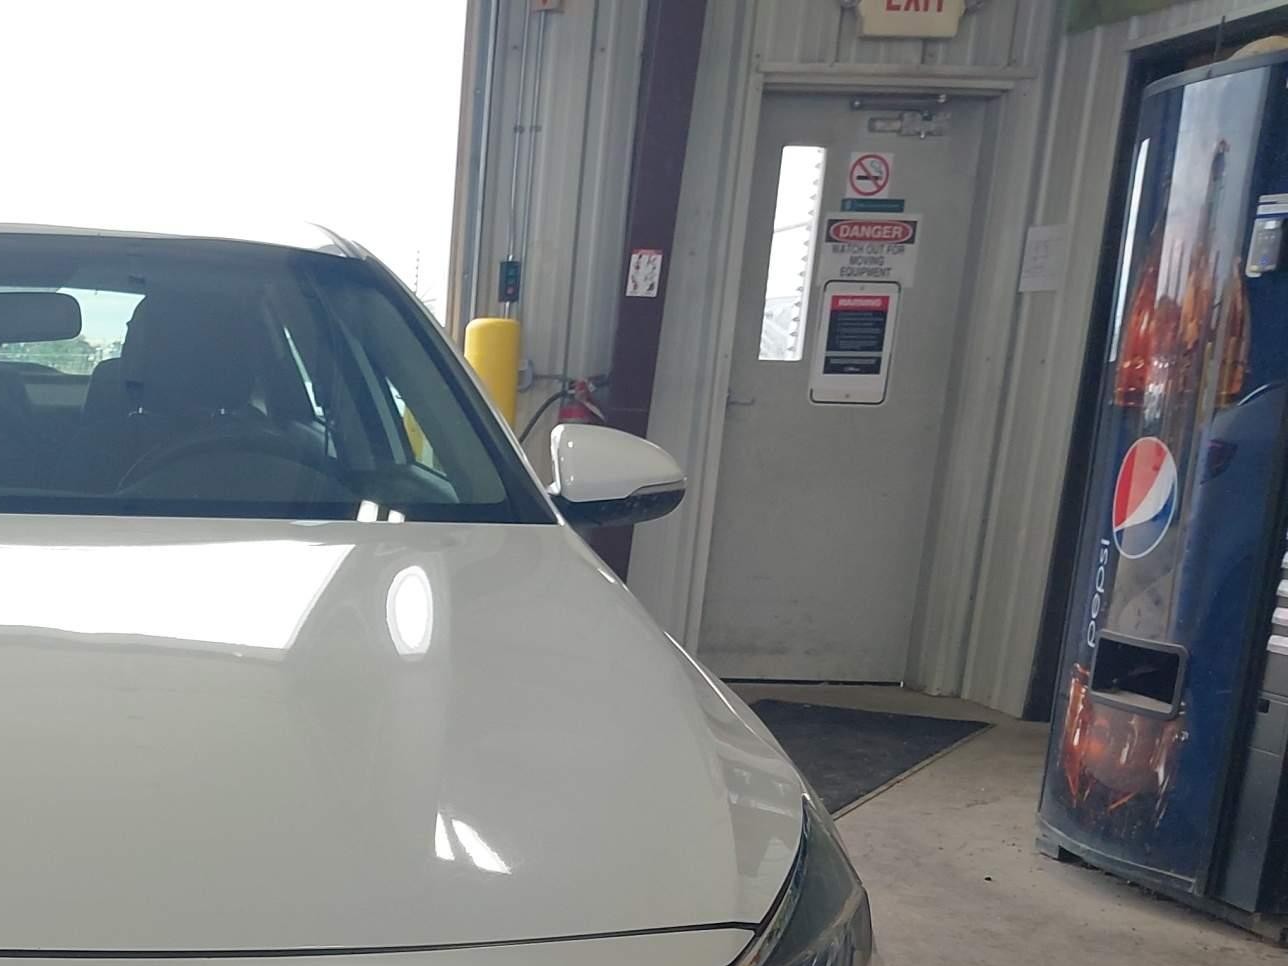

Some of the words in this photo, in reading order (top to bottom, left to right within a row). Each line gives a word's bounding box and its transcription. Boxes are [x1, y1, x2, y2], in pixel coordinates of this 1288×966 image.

[839, 224, 904, 239] DANGER
[832, 244, 864, 254] WATCH
[866, 244, 885, 254] OUT
[887, 245, 905, 255] FOR
[849, 256, 885, 266] MOVING
[839, 267, 892, 277] EQUIPMENT
[1087, 538, 1111, 649] pepsi
